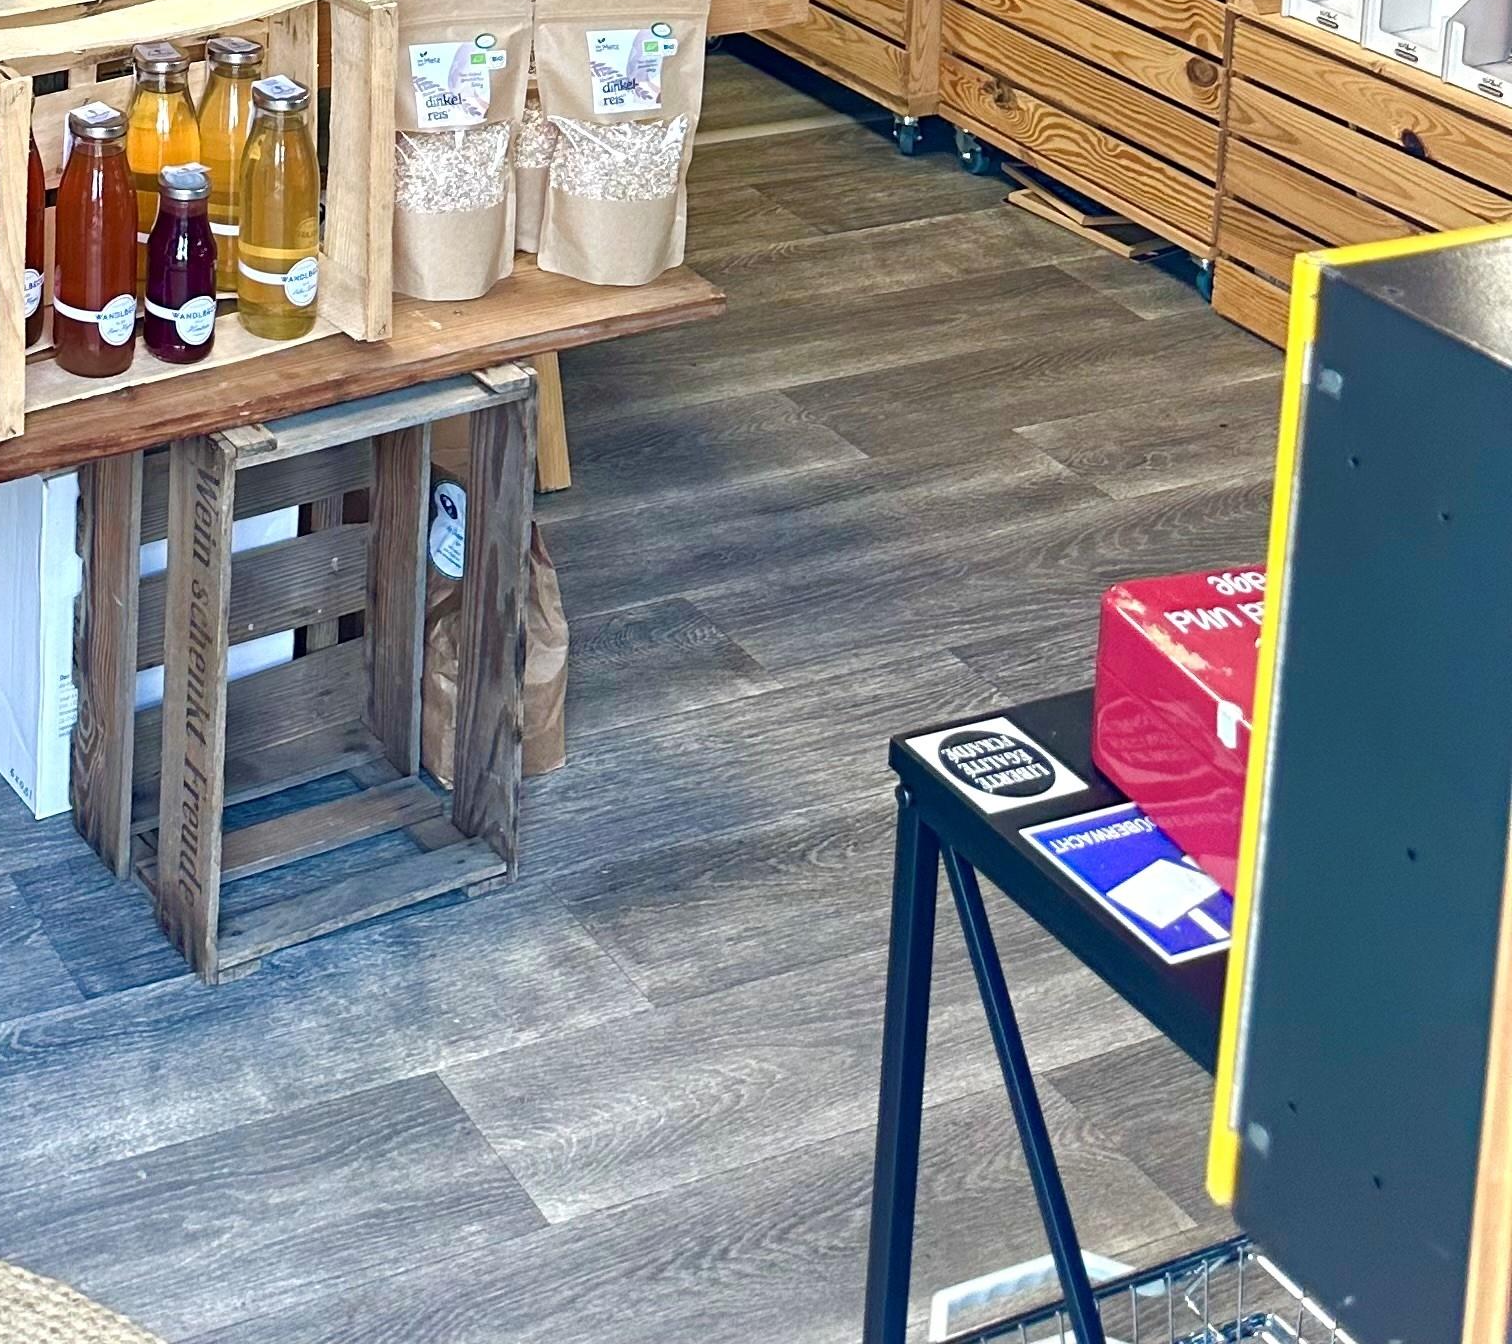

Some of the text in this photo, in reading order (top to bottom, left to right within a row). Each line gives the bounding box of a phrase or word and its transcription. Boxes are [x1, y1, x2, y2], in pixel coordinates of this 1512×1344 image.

[602, 78, 639, 94] dinkel-
[426, 92, 467, 108] dinkel-
[603, 94, 625, 106] reis
[427, 109, 450, 121] reis
[177, 465, 220, 910] Wein schenkt Freude
[957, 748, 1034, 779] ÉGALITÉ
[975, 761, 1050, 792] LIBERTÉ
